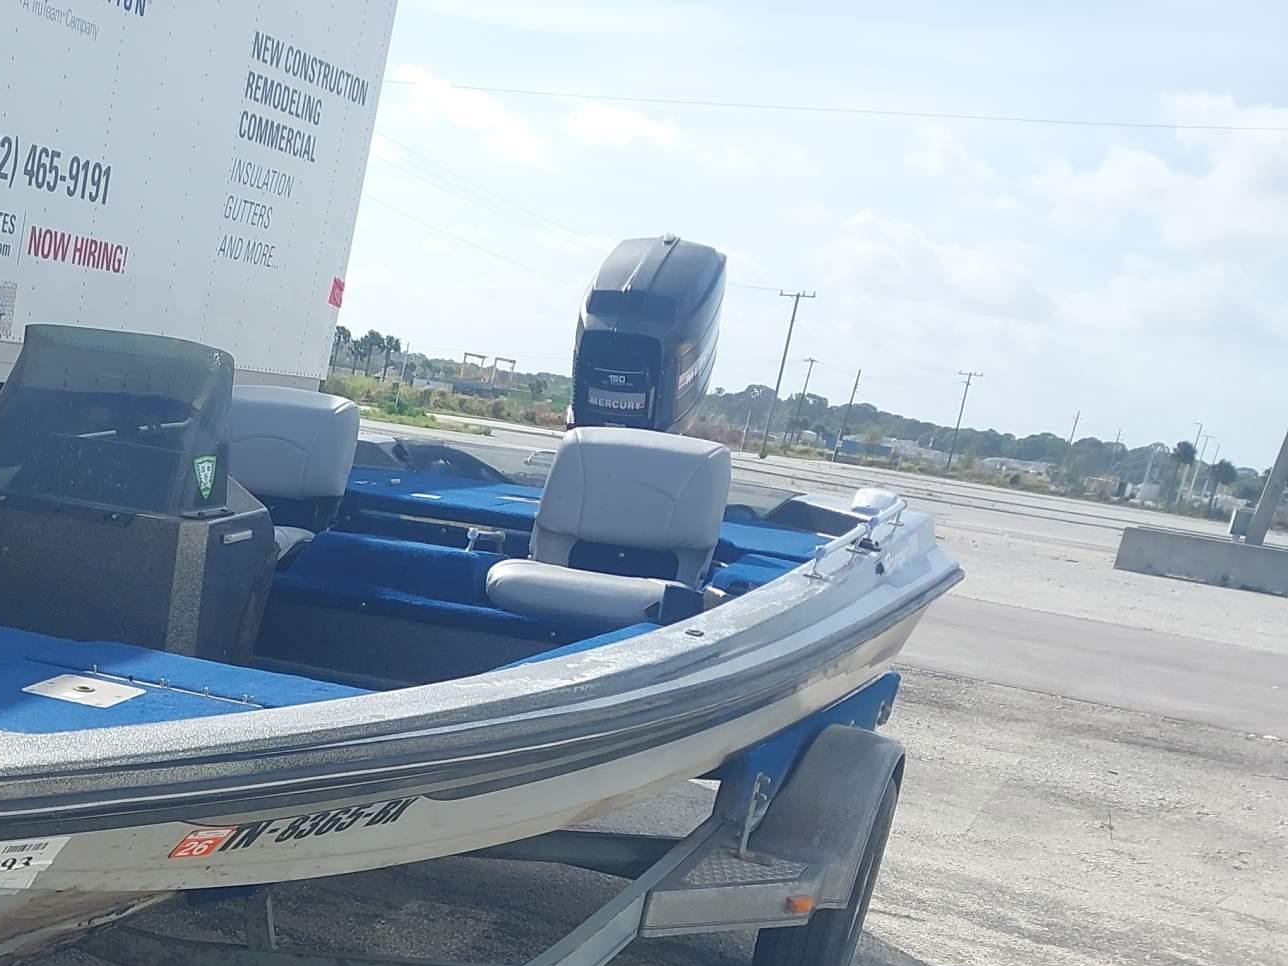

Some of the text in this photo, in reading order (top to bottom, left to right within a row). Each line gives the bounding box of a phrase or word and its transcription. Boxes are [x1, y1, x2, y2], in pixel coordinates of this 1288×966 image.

[65, 8, 100, 40] Company
[252, 31, 368, 106] NEW CONSTRUCTION
[245, 70, 322, 126] REMODELING
[239, 110, 316, 163] COMMERCIAL
[23, 144, 112, 205] 465-9191
[230, 157, 295, 198] INSULATION
[224, 195, 273, 229] GUTTERS
[27, 225, 129, 275] NOW HIRING!
[217, 234, 244, 261] AND
[590, 397, 642, 410] MERCURY
[174, 840, 214, 857] 26
